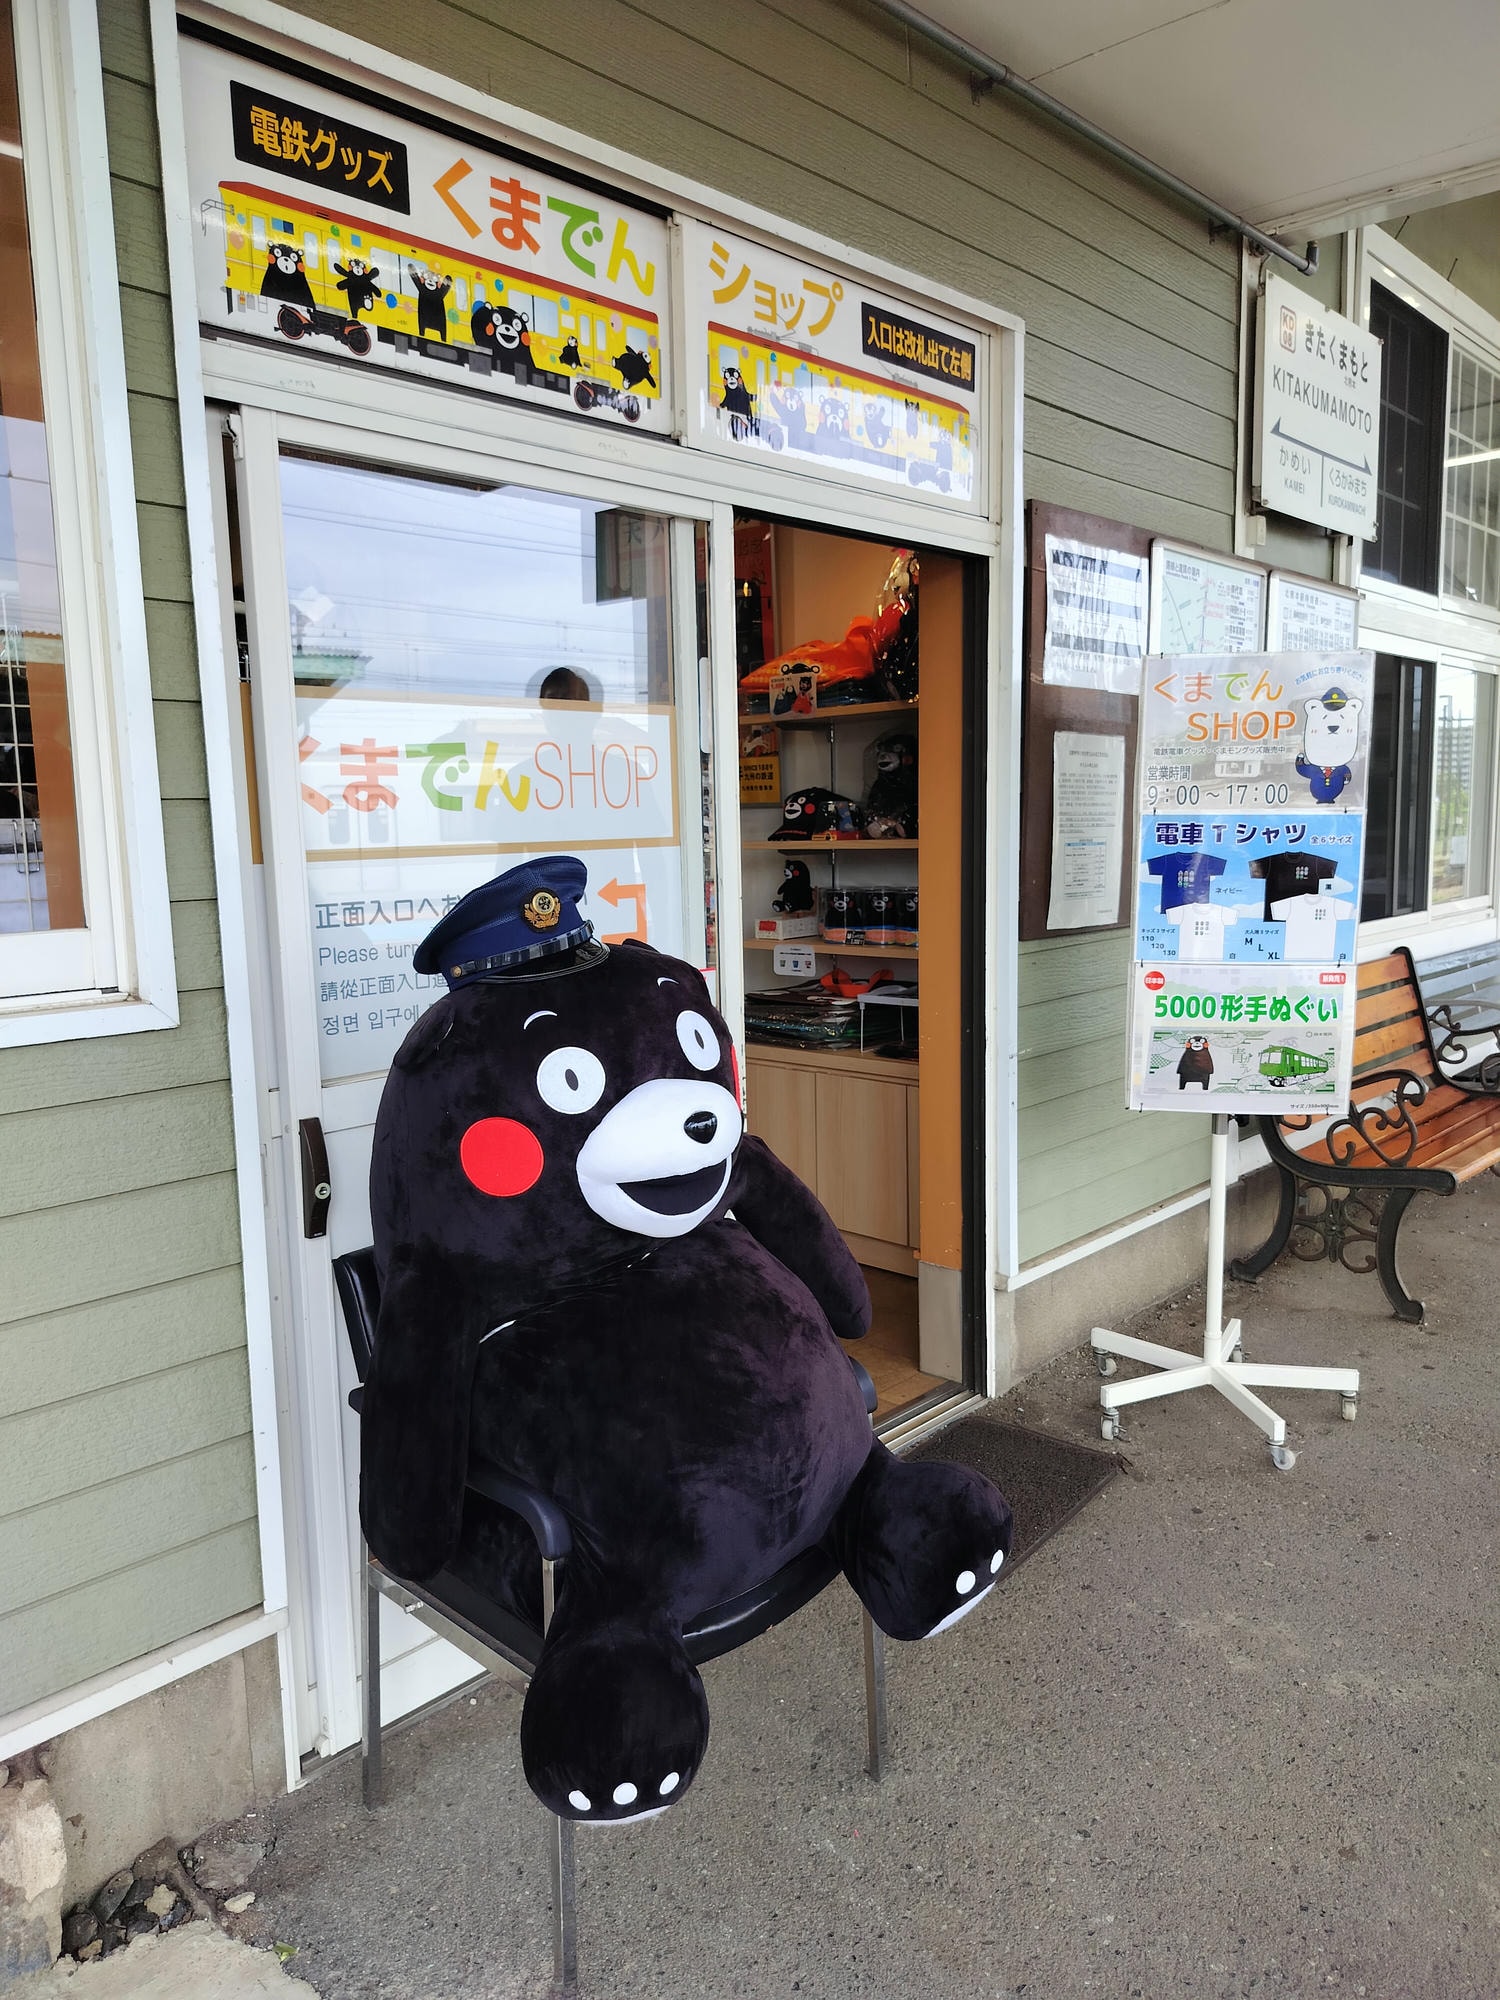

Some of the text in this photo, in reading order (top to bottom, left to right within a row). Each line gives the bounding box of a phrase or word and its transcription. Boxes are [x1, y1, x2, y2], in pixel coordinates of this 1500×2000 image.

[250, 106, 394, 195] 電鉄グッズ
[433, 158, 655, 297] くまでん
[708, 241, 844, 337] ショップ
[867, 315, 972, 382] 入口は改札出て左側
[1305, 319, 1368, 383] きたくまもと
[1273, 364, 1372, 434] KITAKUMAMOTO
[1279, 446, 1311, 475] かめい
[1284, 478, 1305, 495] KAMEI
[1329, 467, 1367, 497] くろかみまち
[1153, 670, 1284, 703] くまでん
[1186, 711, 1296, 741] SHOP
[1148, 765, 1191, 781] 営業時間
[1155, 823, 1307, 845] 電車Tシャツ
[1215, 886, 1243, 894] ネイビー
[319, 946, 379, 966] Please
[1267, 952, 1280, 960] XL
[323, 1004, 419, 1036] 정면 입구에
[1154, 995, 1338, 1022] 5000形手ぬぐい
